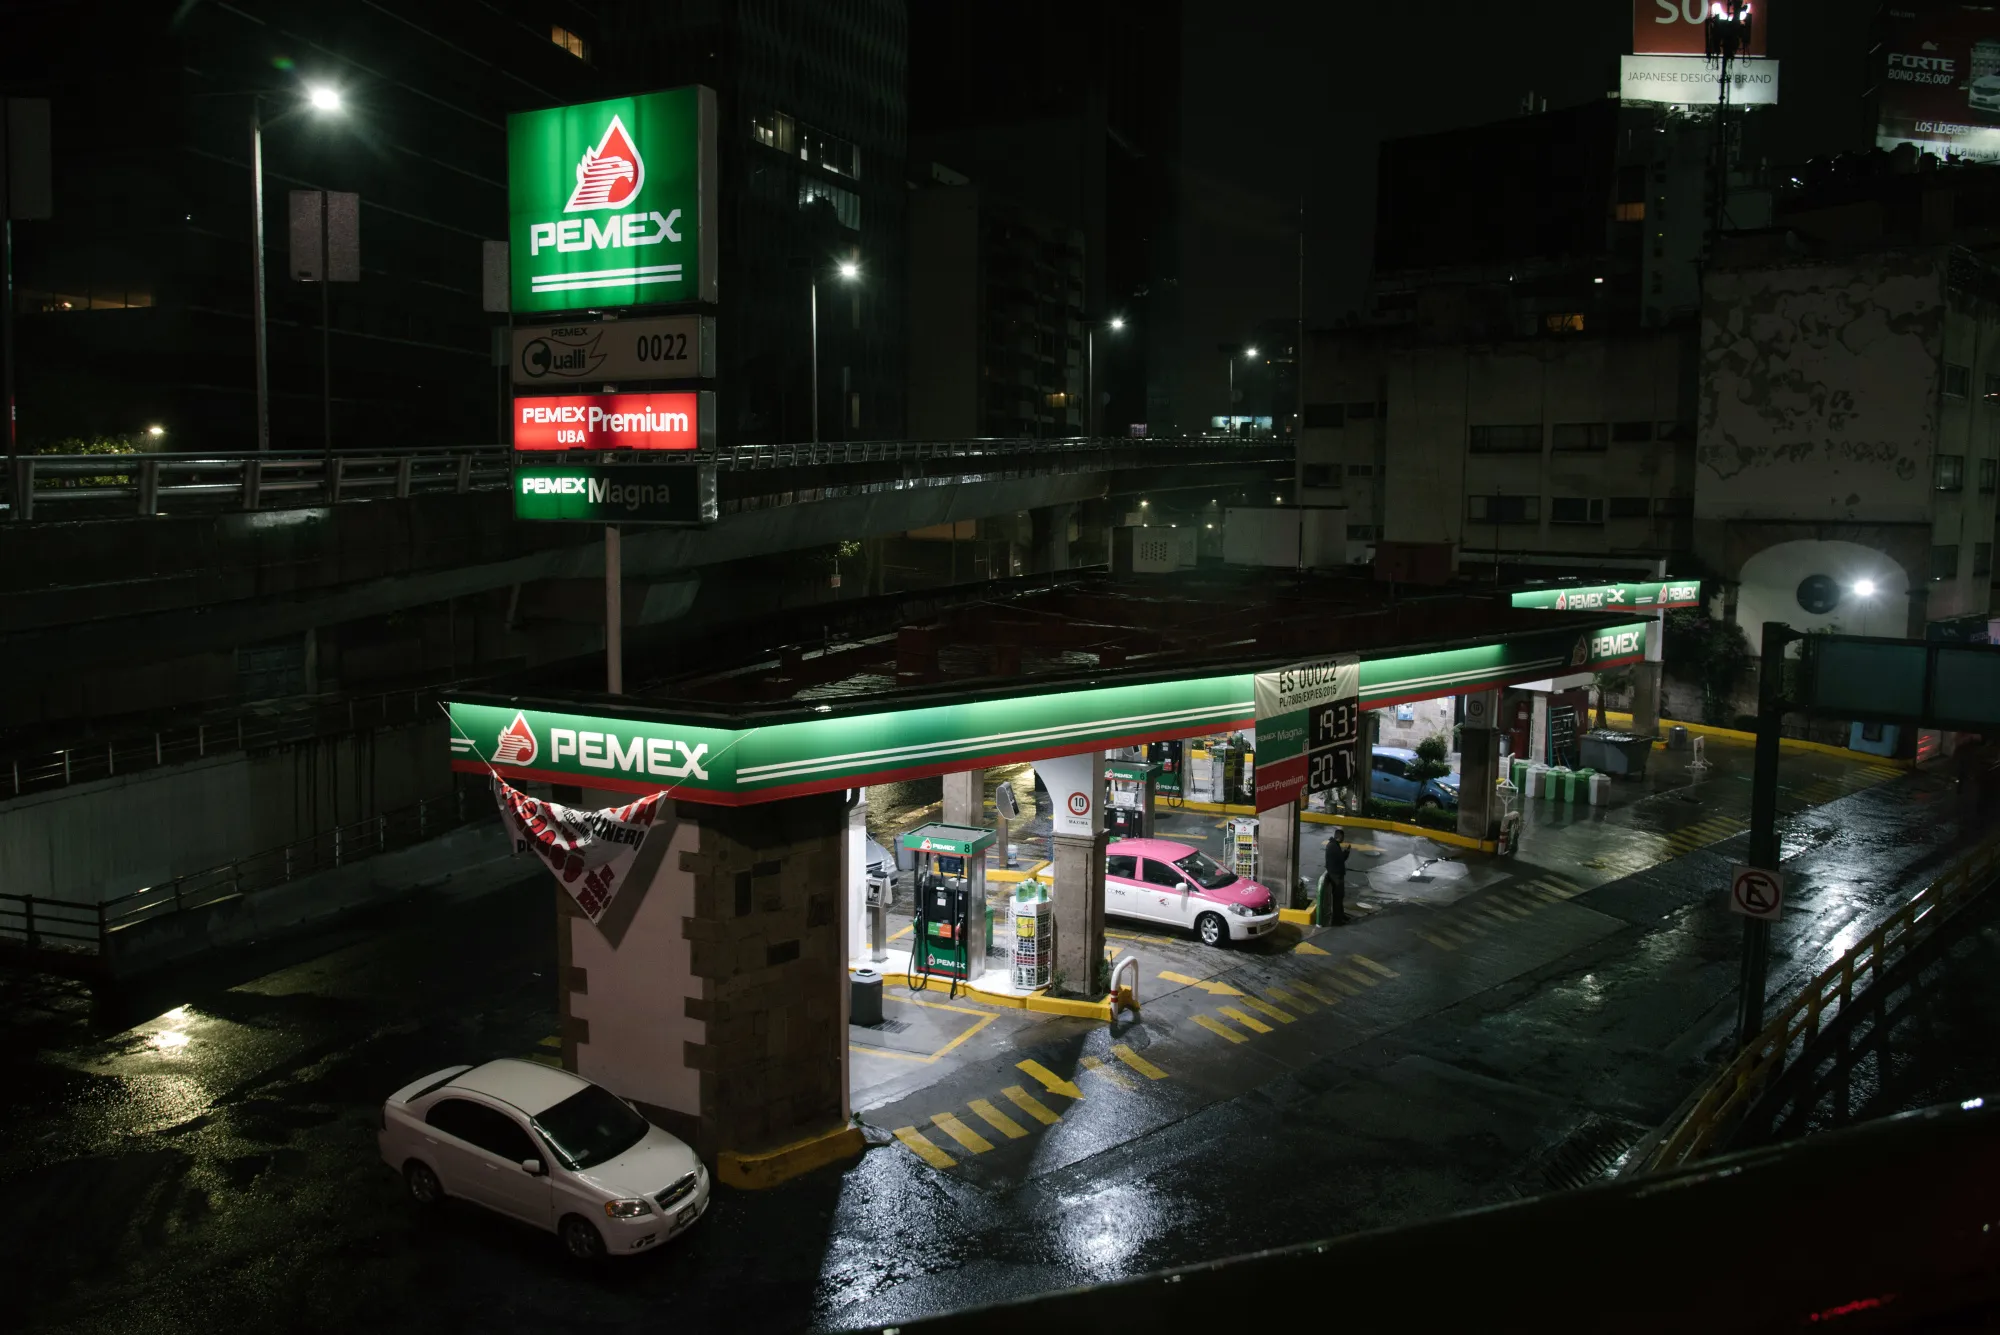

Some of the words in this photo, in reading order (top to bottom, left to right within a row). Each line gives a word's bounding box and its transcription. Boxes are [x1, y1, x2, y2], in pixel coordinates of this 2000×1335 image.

[1887, 53, 1955, 72] FORTE
[1628, 72, 1678, 82] JAPANESE
[1735, 74, 1772, 84] BRAND
[1888, 69, 1913, 81] BONO
[1914, 121, 1932, 133] LOS
[1933, 121, 1969, 136] LÍDERES
[530, 208, 682, 256] PEMEX
[551, 327, 588, 337] PEMEX
[637, 333, 687, 362] 0022
[522, 406, 586, 423] PEMEX
[588, 406, 688, 432] Premium
[557, 429, 585, 443] UBA
[522, 477, 586, 495] PEMEX
[588, 477, 670, 511] Magna
[1669, 587, 1697, 601] PEMEX
[1568, 593, 1604, 611] PEMEX
[1591, 631, 1640, 659] PEMEX
[1280, 670, 1295, 694] ES
[1299, 660, 1337, 689] 00022
[1277, 727, 1304, 741] Magna
[550, 728, 708, 781] PEMEX
[1275, 775, 1304, 790] Premium
[1074, 797, 1084, 808] 10
[932, 843, 956, 851] PEMEX
[964, 843, 970, 853] 8
